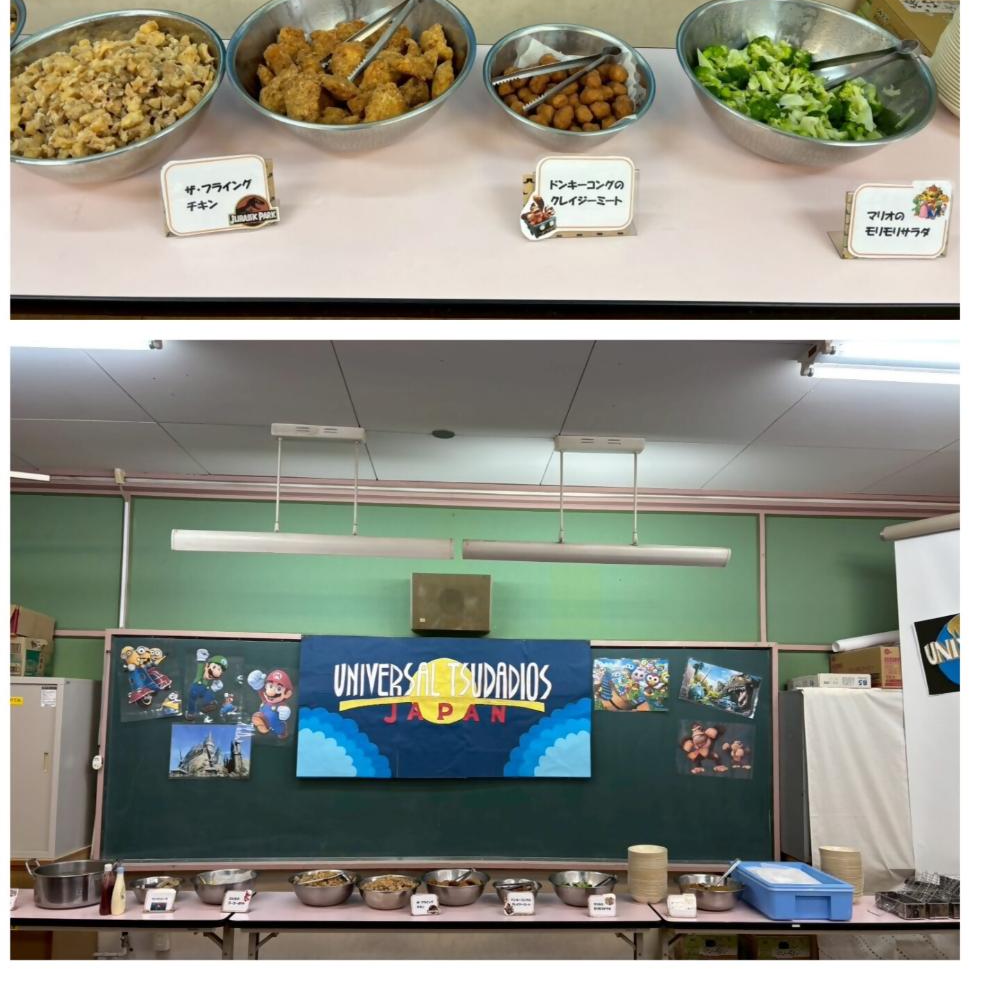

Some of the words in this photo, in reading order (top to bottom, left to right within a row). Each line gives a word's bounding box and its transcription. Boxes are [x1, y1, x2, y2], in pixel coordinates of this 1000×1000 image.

[550, 180, 624, 190] ドンキーコングの
[187, 200, 218, 212] チキン
[551, 196, 623, 206] クレイジーミート
[258, 211, 277, 221] PARK
[867, 210, 905, 221] マリオの
[865, 226, 930, 237] モリモリサラダ
[923, 639, 960, 665] UNI
[334, 663, 440, 697] UNIVERSAL
[449, 662, 552, 700] TSUDADIOS
[383, 701, 506, 724] JAPAN
